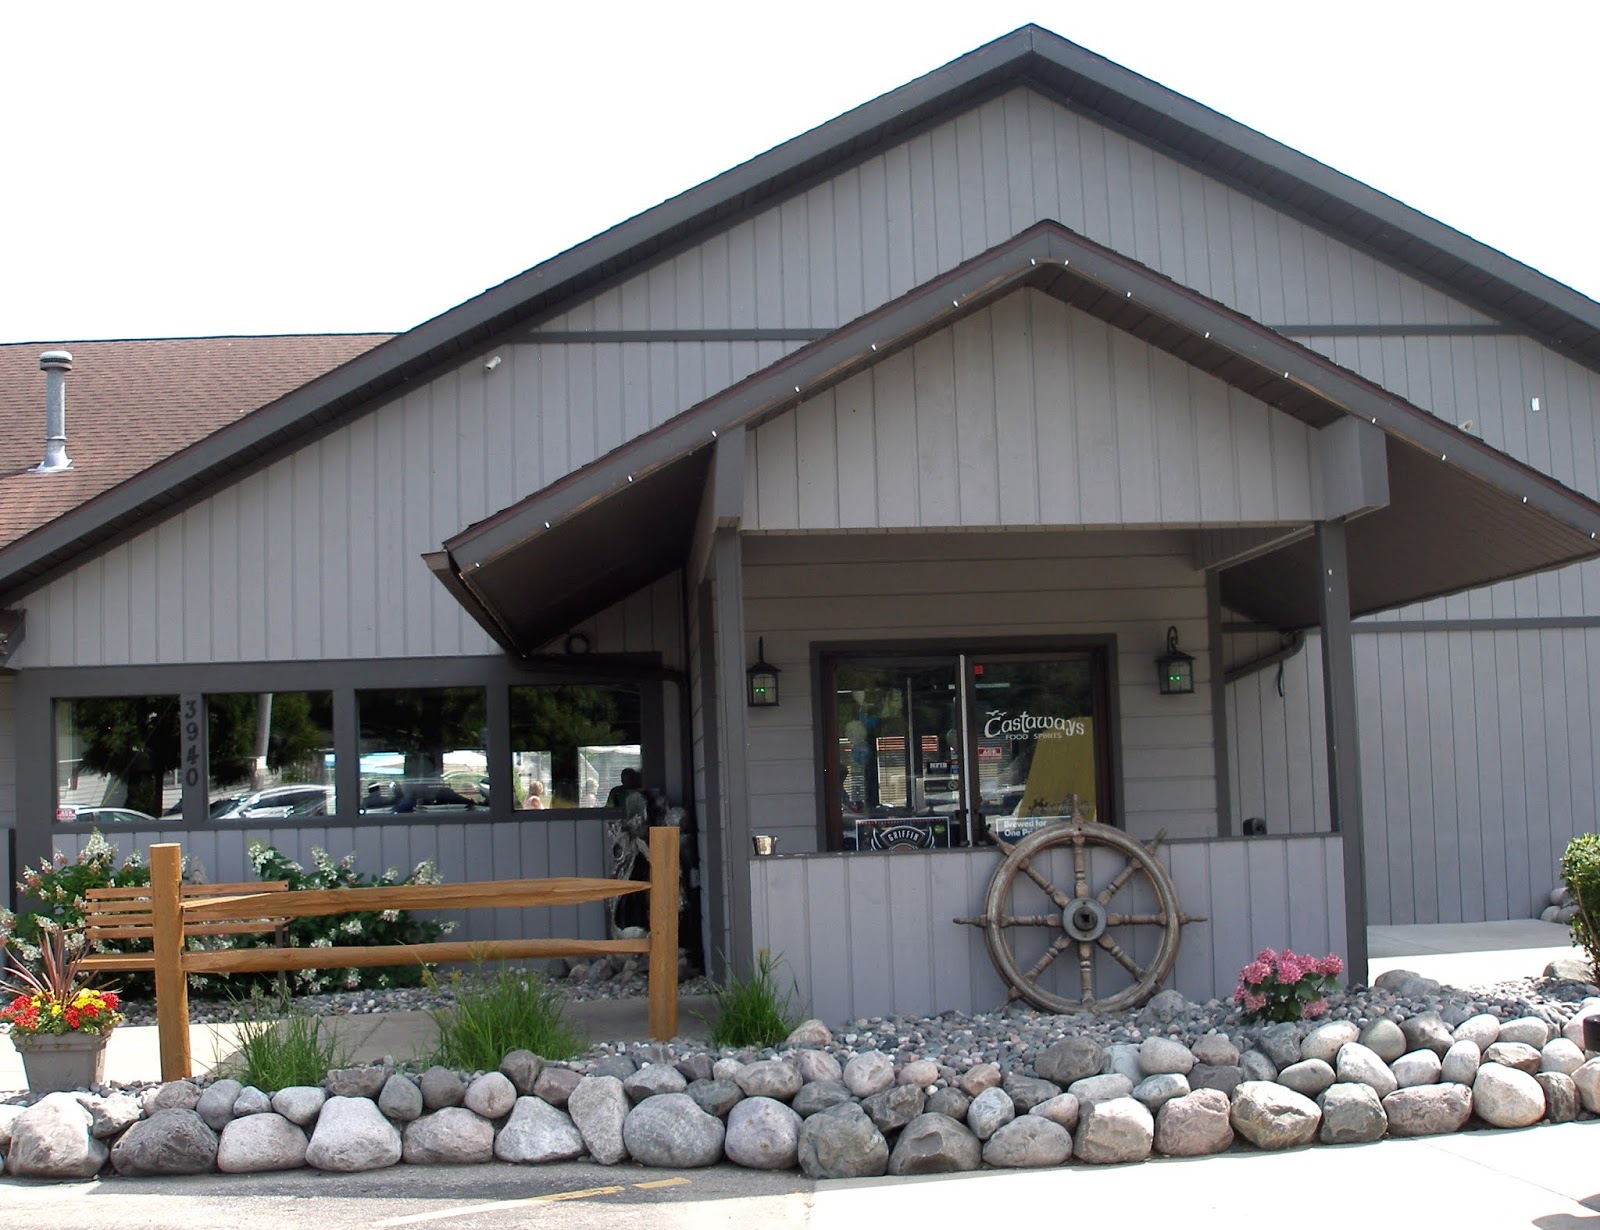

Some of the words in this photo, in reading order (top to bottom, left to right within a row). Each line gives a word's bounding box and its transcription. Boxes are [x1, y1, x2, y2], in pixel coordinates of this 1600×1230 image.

[984, 710, 1085, 738] Castaways
[1033, 732, 1062, 740] SPIRITS
[185, 700, 199, 787] 3940
[1003, 819, 1035, 829] Brewed
[1035, 818, 1047, 828] for
[887, 829, 920, 842] GRIFFIN
[1004, 828, 1021, 838] One
